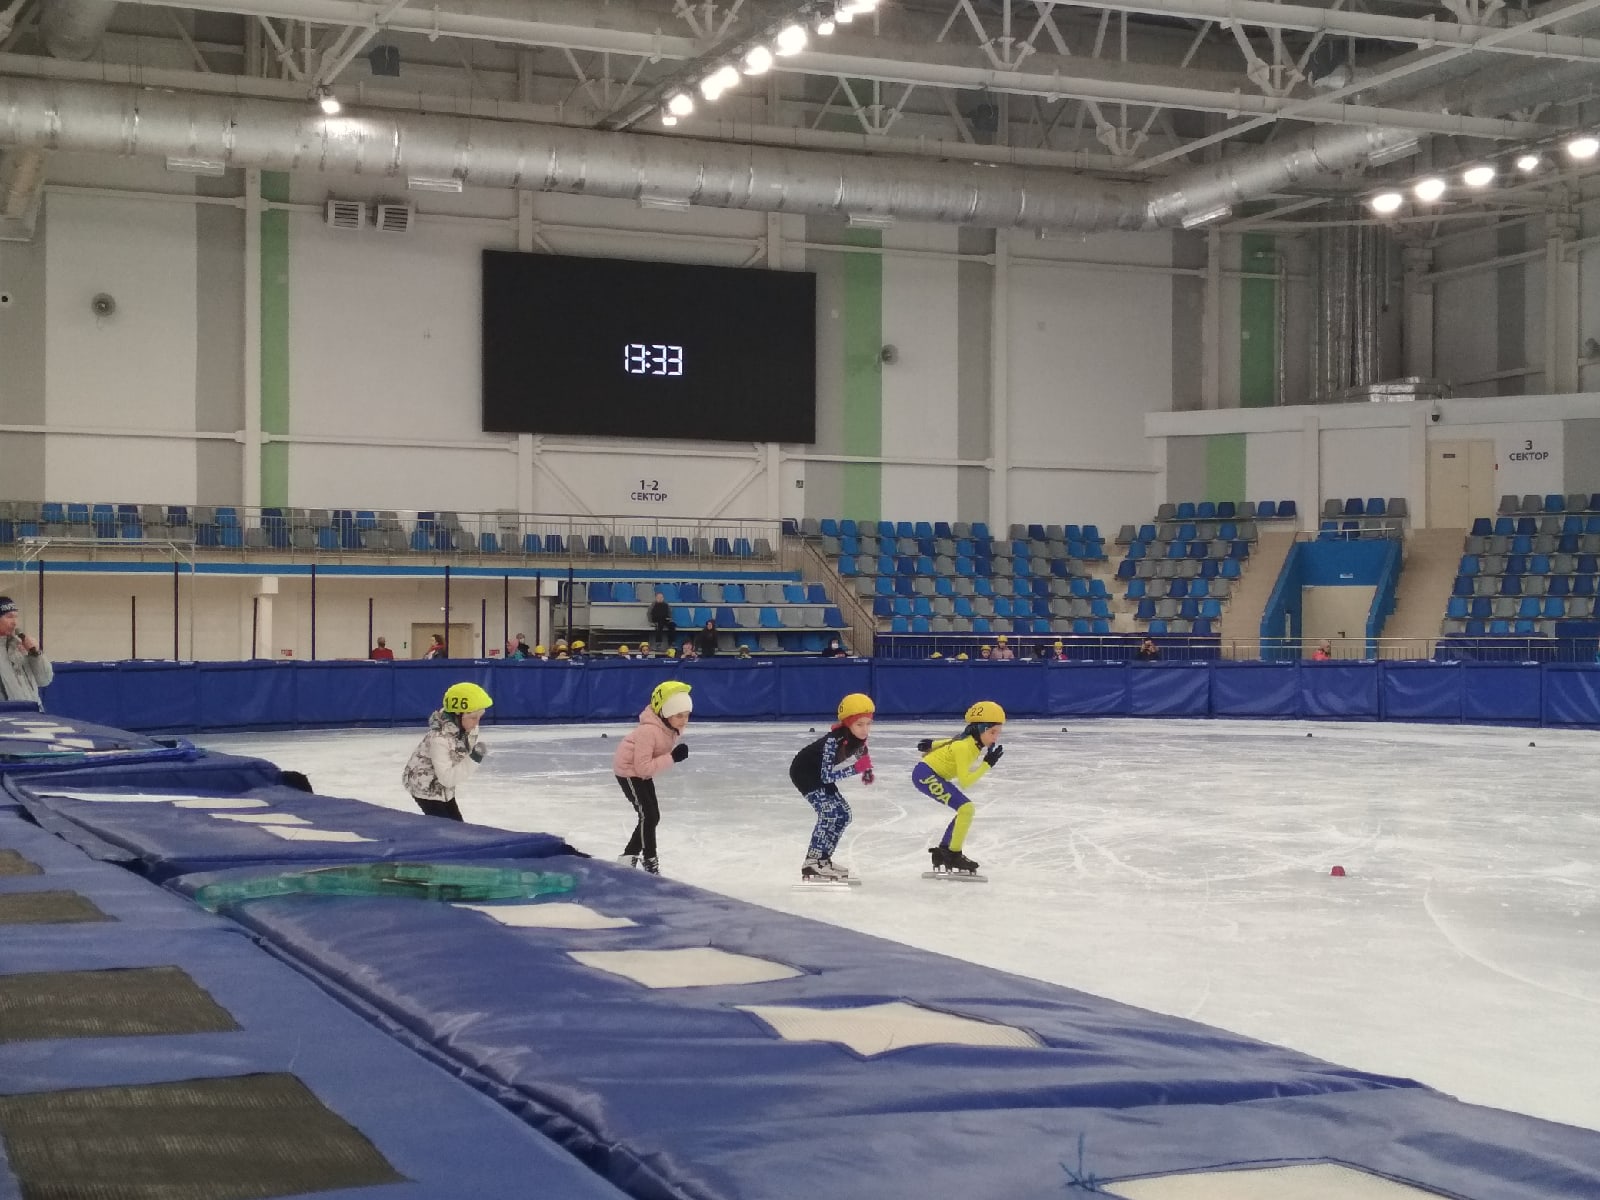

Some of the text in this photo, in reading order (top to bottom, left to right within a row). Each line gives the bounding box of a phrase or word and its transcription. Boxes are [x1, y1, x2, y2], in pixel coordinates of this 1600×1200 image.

[624, 344, 683, 376] 13:33
[1525, 440, 1533, 450] 3
[1509, 452, 1549, 461] СЕКТОР
[640, 480, 659, 491] 1-2
[630, 492, 668, 502] СЕКТОР
[445, 697, 469, 710] 126
[970, 706, 984, 717] 22
[919, 775, 952, 805] УФА
